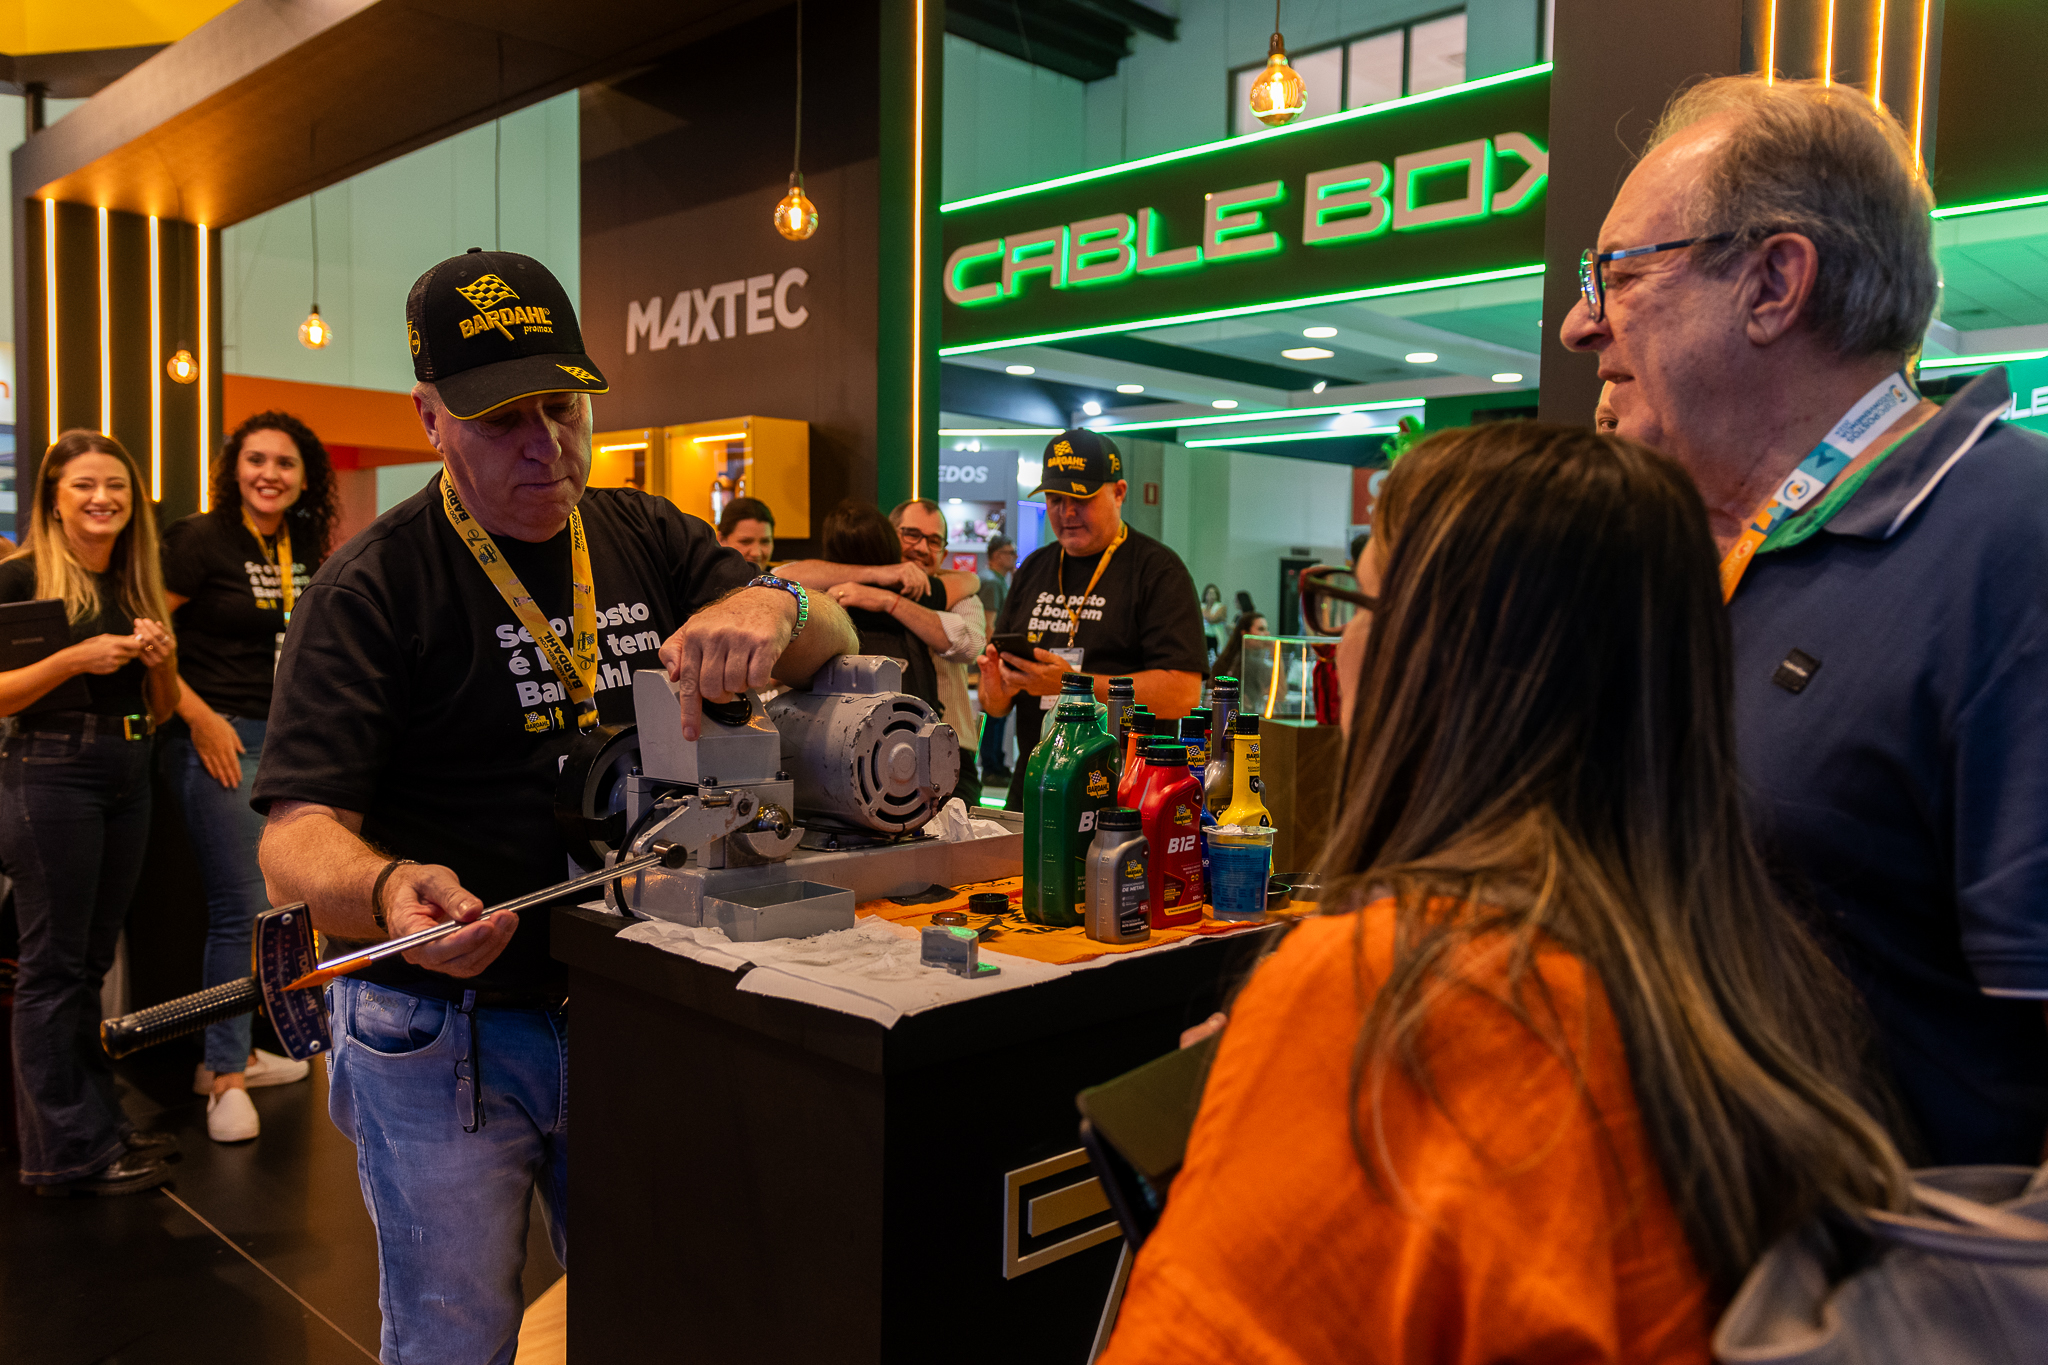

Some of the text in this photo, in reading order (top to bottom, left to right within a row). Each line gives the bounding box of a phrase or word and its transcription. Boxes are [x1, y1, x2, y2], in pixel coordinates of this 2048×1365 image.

[943, 180, 1284, 306] CABLE
[459, 306, 553, 340] BARDAHL
[626, 267, 809, 355] MAXTEC
[523, 325, 553, 335] promax
[1032, 604, 1042, 617] é
[1036, 591, 1054, 604] Se
[1055, 594, 1066, 604] o
[568, 602, 650, 634] osto
[508, 649, 531, 675] é
[607, 630, 661, 656] tem
[541, 629, 584, 690] BARDAHL
[516, 661, 632, 707] Barahl
[1167, 835, 1196, 854] B12
